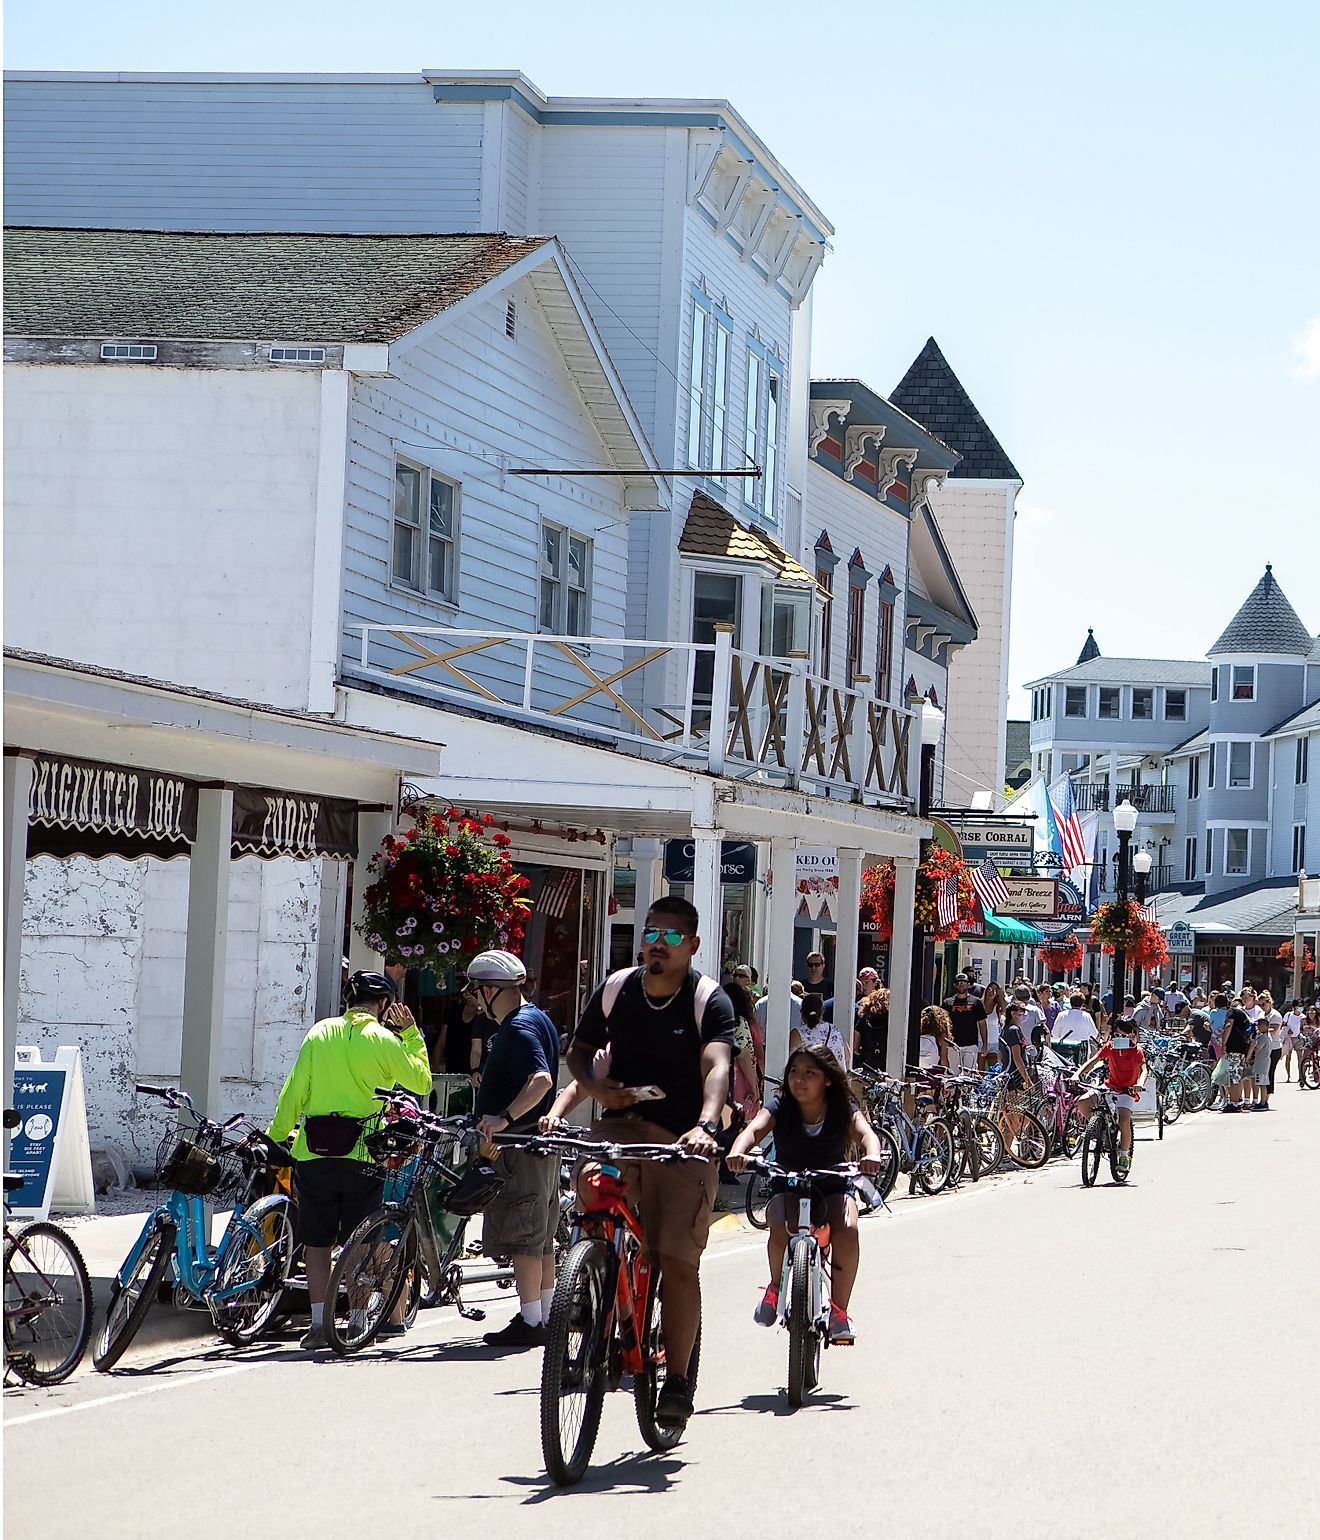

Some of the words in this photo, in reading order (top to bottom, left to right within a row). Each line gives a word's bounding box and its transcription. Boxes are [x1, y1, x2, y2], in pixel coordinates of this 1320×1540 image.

[148, 777, 185, 834] 1887
[261, 796, 319, 850] FUDGE
[957, 831, 981, 842] RSE
[985, 831, 1028, 843] CORRAL
[795, 855, 820, 865] KED
[1024, 887, 1053, 898] Breeze
[1016, 901, 1028, 909] Art
[1169, 932, 1191, 940] GREAT
[872, 943, 888, 952] Mall
